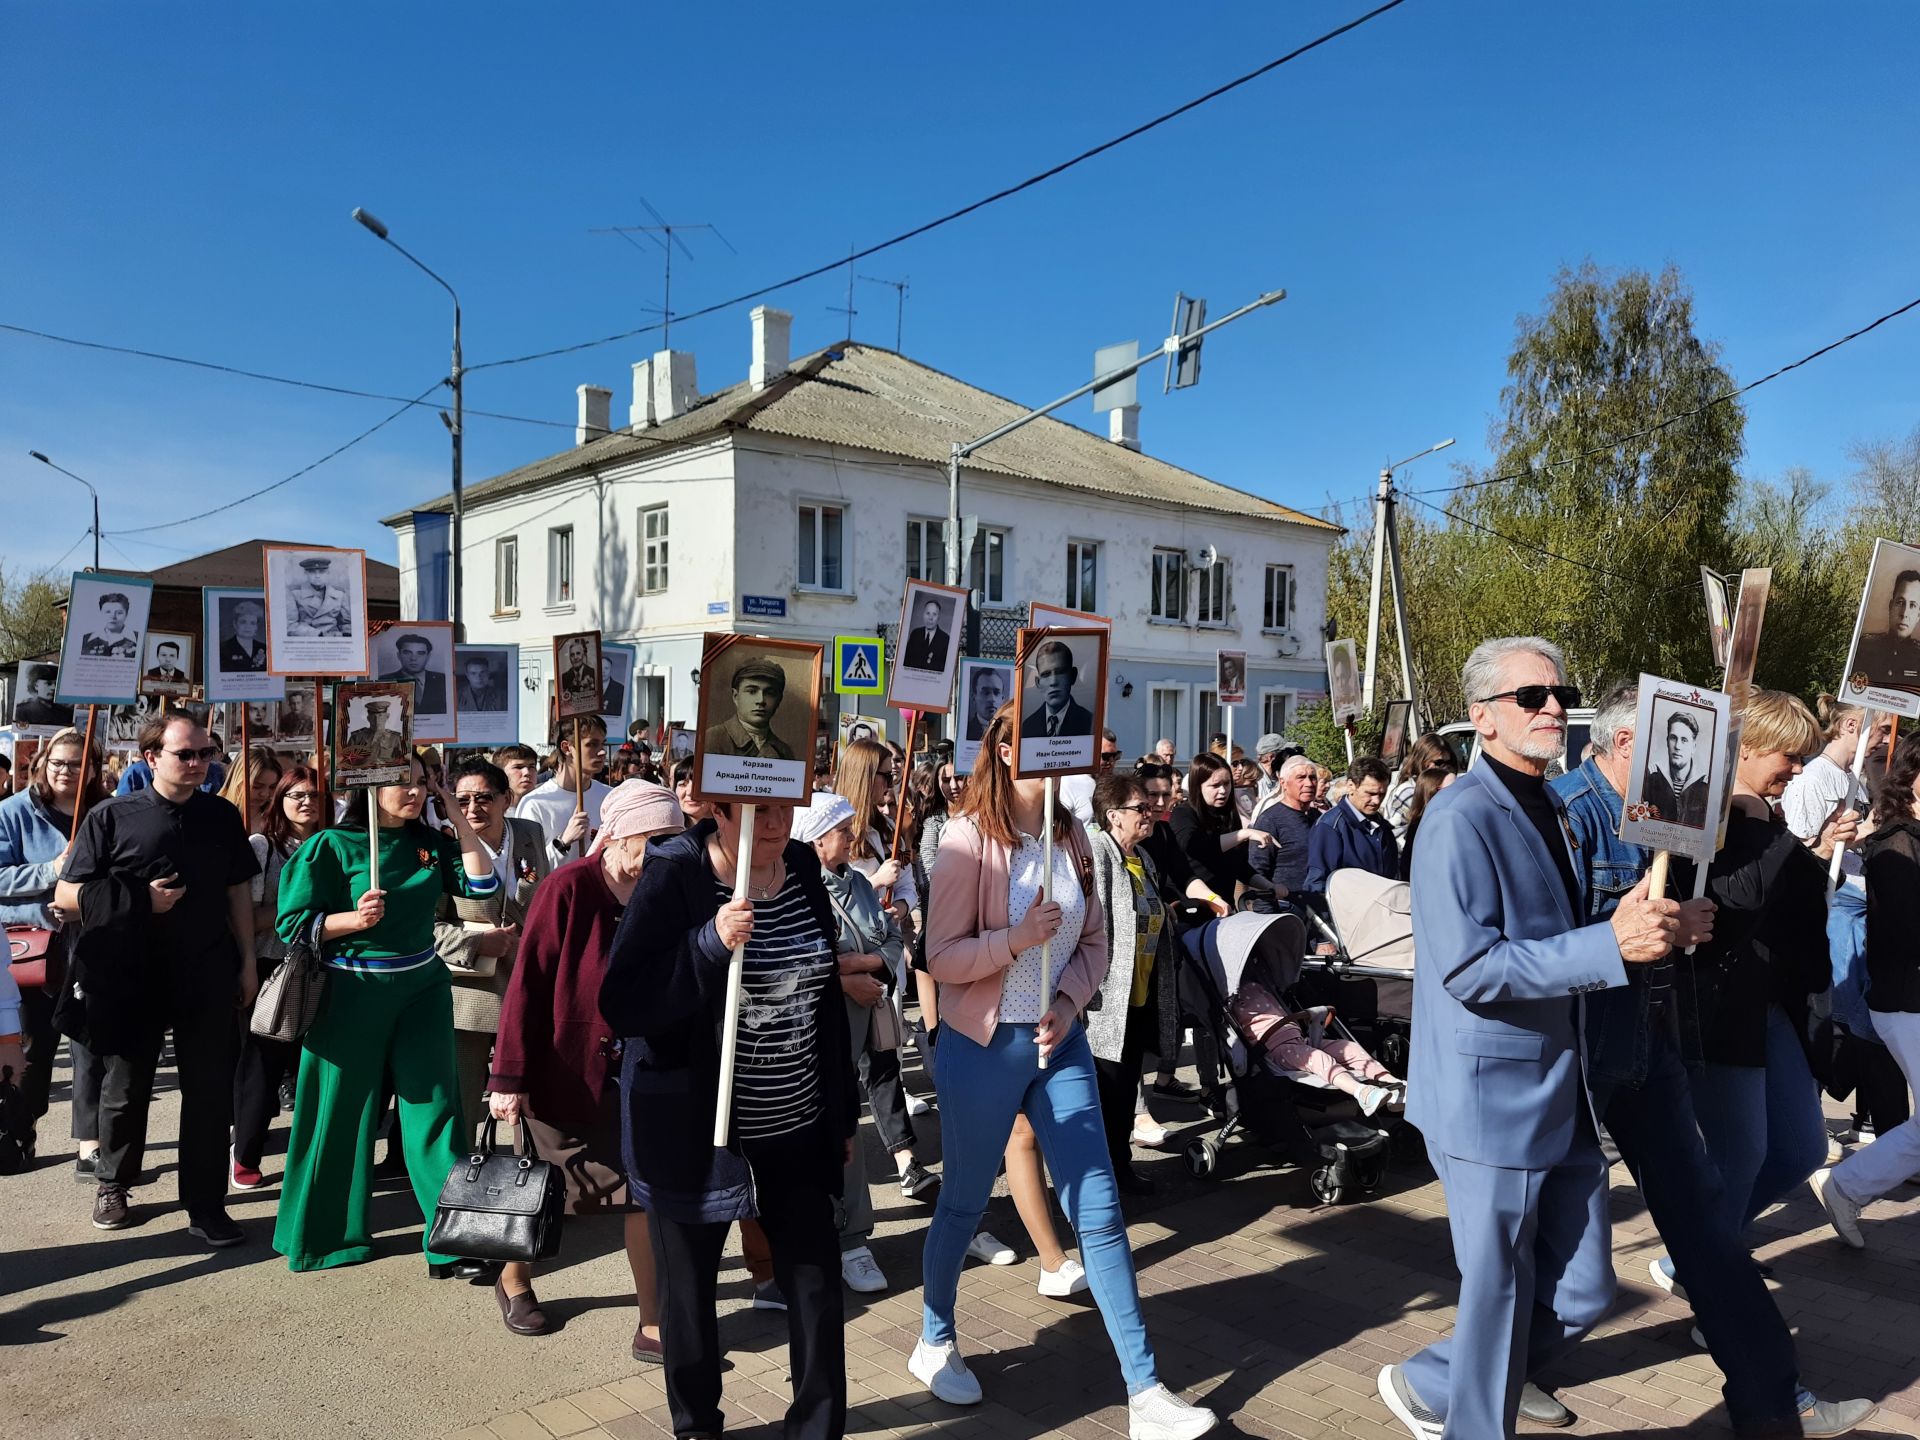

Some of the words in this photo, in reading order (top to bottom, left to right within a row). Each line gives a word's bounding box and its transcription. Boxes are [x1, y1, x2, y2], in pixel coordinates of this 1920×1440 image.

[742, 760, 773, 769] Карзаев
[1043, 760, 1071, 768] 1917-1942
[715, 770, 750, 781] Аркадий
[751, 773, 795, 783] Платонович
[734, 784, 772, 794] 1907-1942
